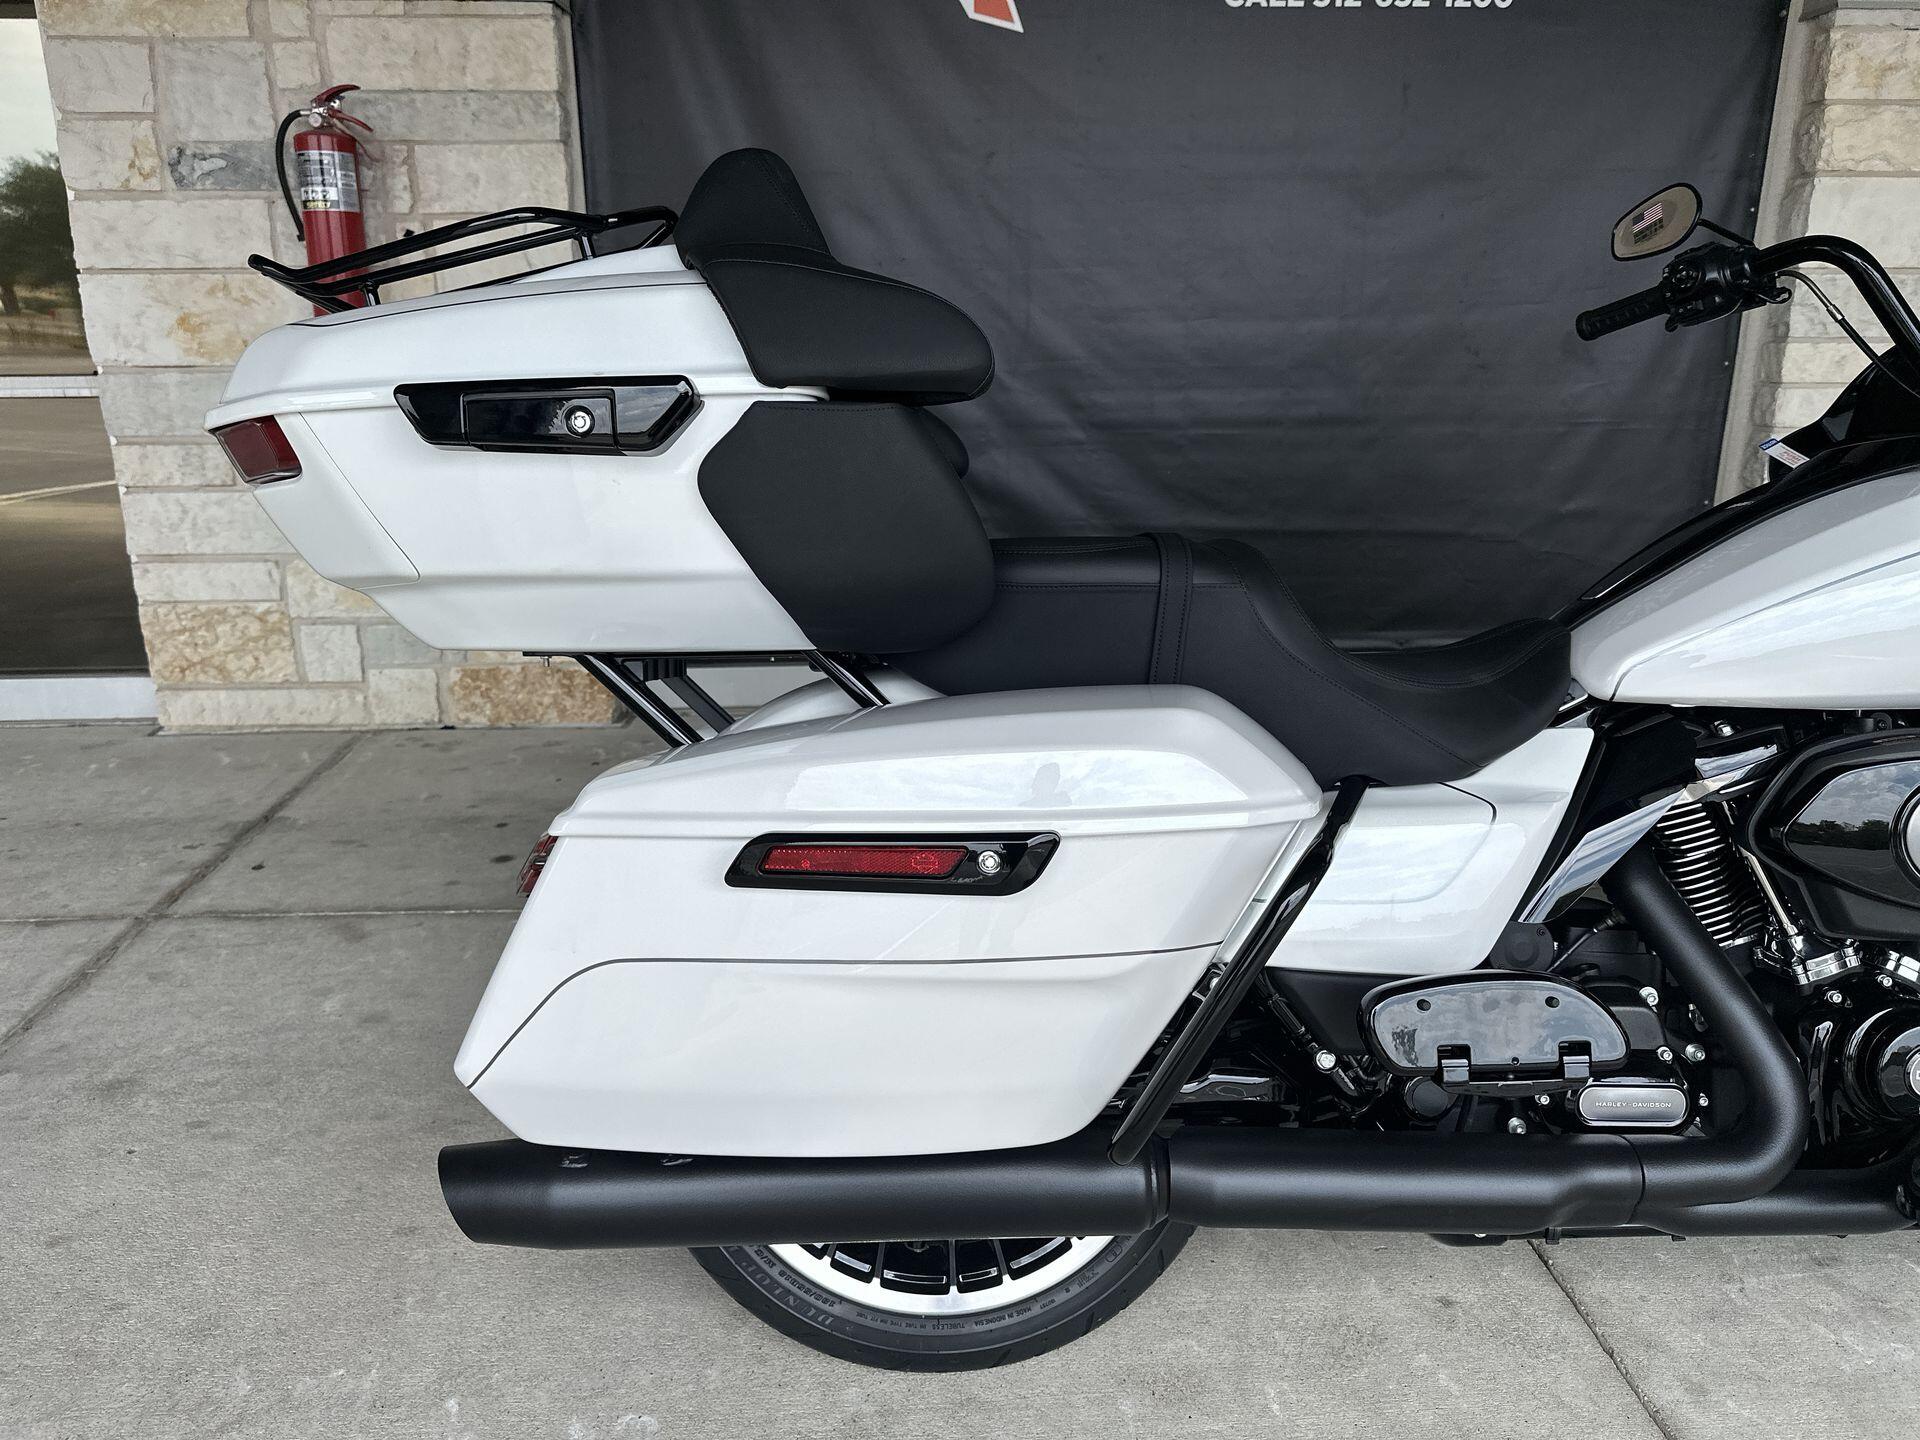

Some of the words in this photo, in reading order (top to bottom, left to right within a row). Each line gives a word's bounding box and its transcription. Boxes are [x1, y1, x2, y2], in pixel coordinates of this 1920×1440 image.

[740, 1257, 834, 1326] DUNLOP
[1014, 1305, 1032, 1317] MADE
[973, 1314, 1006, 1326] INDONESIA
